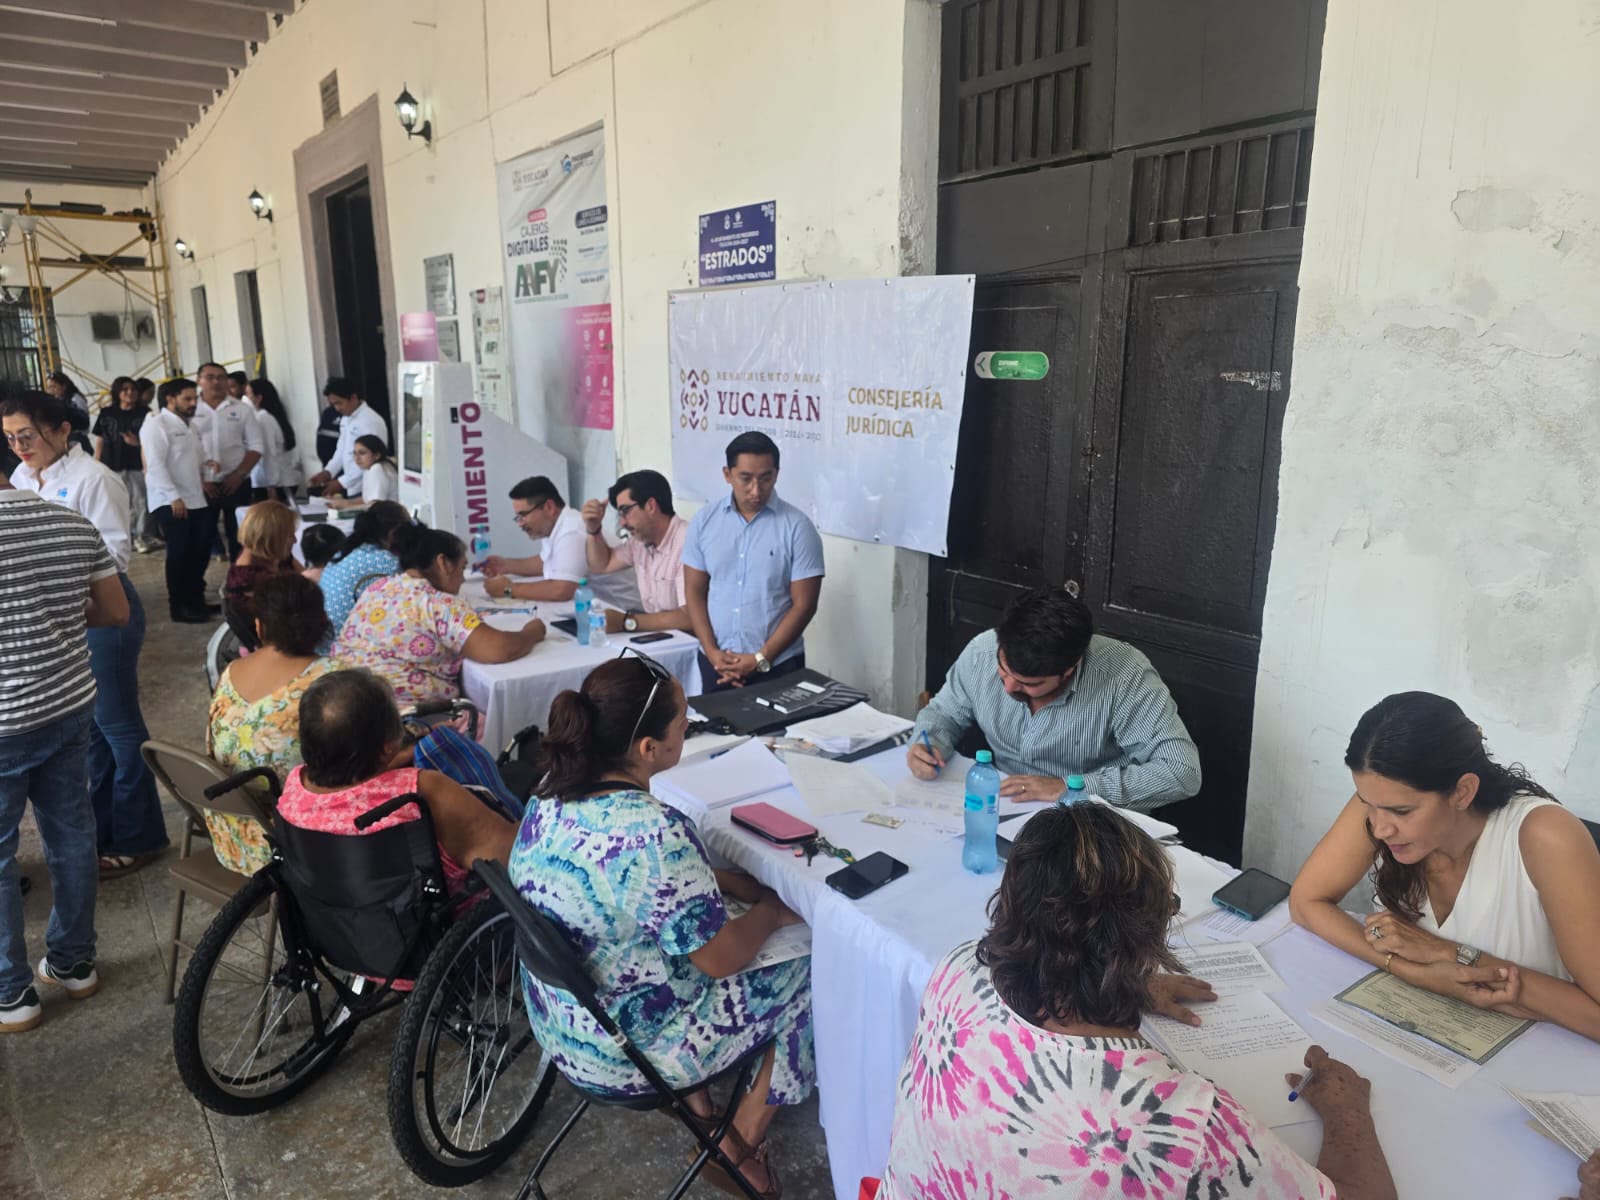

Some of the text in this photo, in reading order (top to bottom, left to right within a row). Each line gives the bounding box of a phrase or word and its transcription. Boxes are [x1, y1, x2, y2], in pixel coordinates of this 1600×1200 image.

[520, 221, 549, 238] CAJEROS
[507, 235, 549, 258] DIGITALES
[515, 258, 560, 298] AAFY
[717, 389, 821, 422] YUCATÁN
[848, 385, 943, 411] CONSEJERÍA
[846, 412, 914, 438] JURÍDICA
